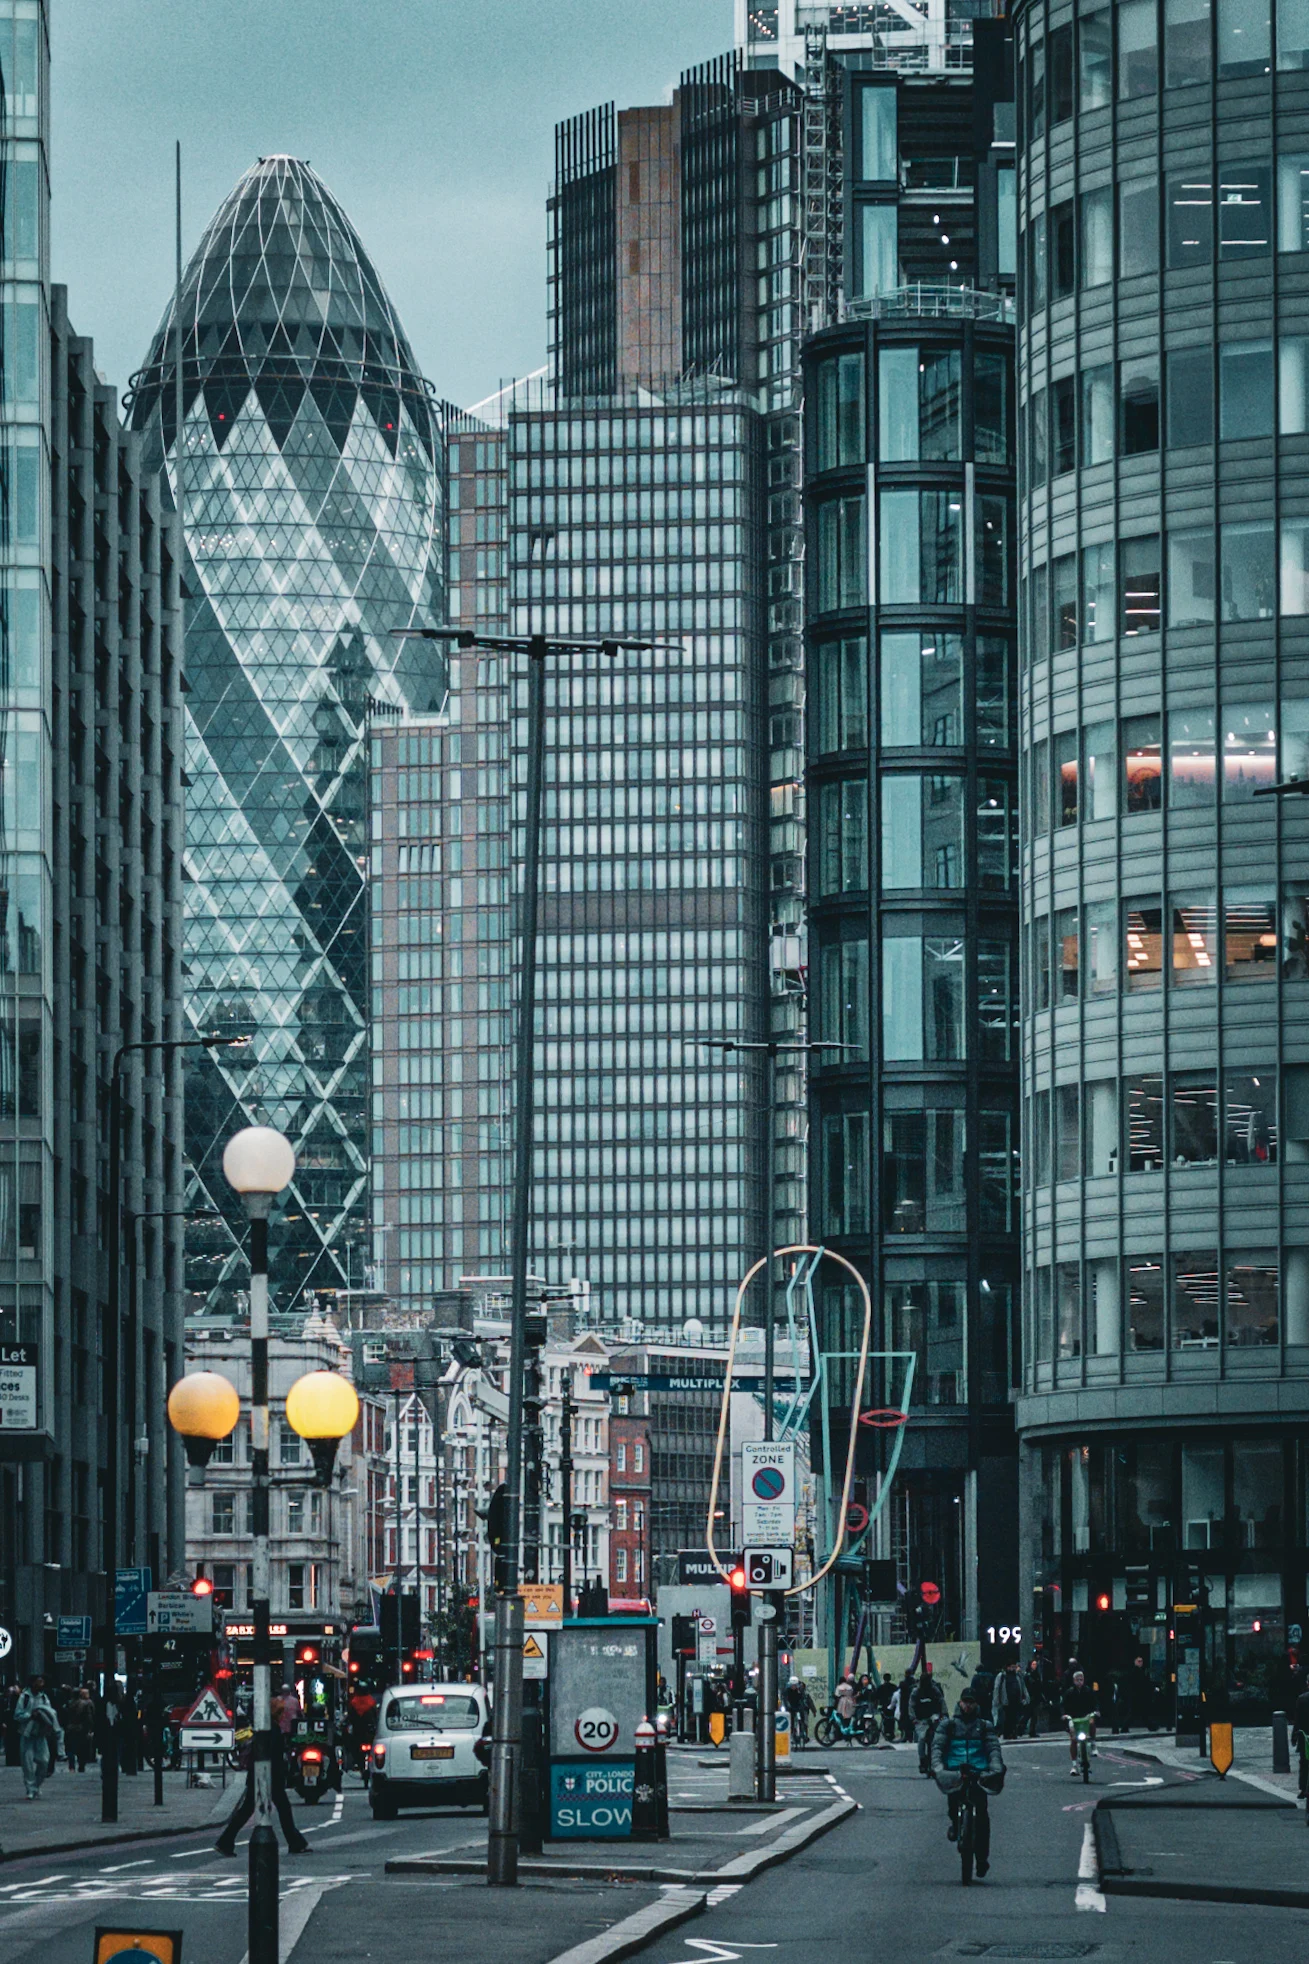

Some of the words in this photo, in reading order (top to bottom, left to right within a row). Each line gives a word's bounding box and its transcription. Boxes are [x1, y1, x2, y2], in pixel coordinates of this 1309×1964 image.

[2, 1347, 26, 1362] Let
[669, 1378, 740, 1389] MULTIPLX
[752, 1455, 785, 1464] ZONE
[685, 1563, 736, 1574] MULTIP
[987, 1626, 1022, 1644] 199
[163, 1640, 176, 1650] 42
[583, 1721, 611, 1738] 20
[586, 1779, 632, 1793] POLIC
